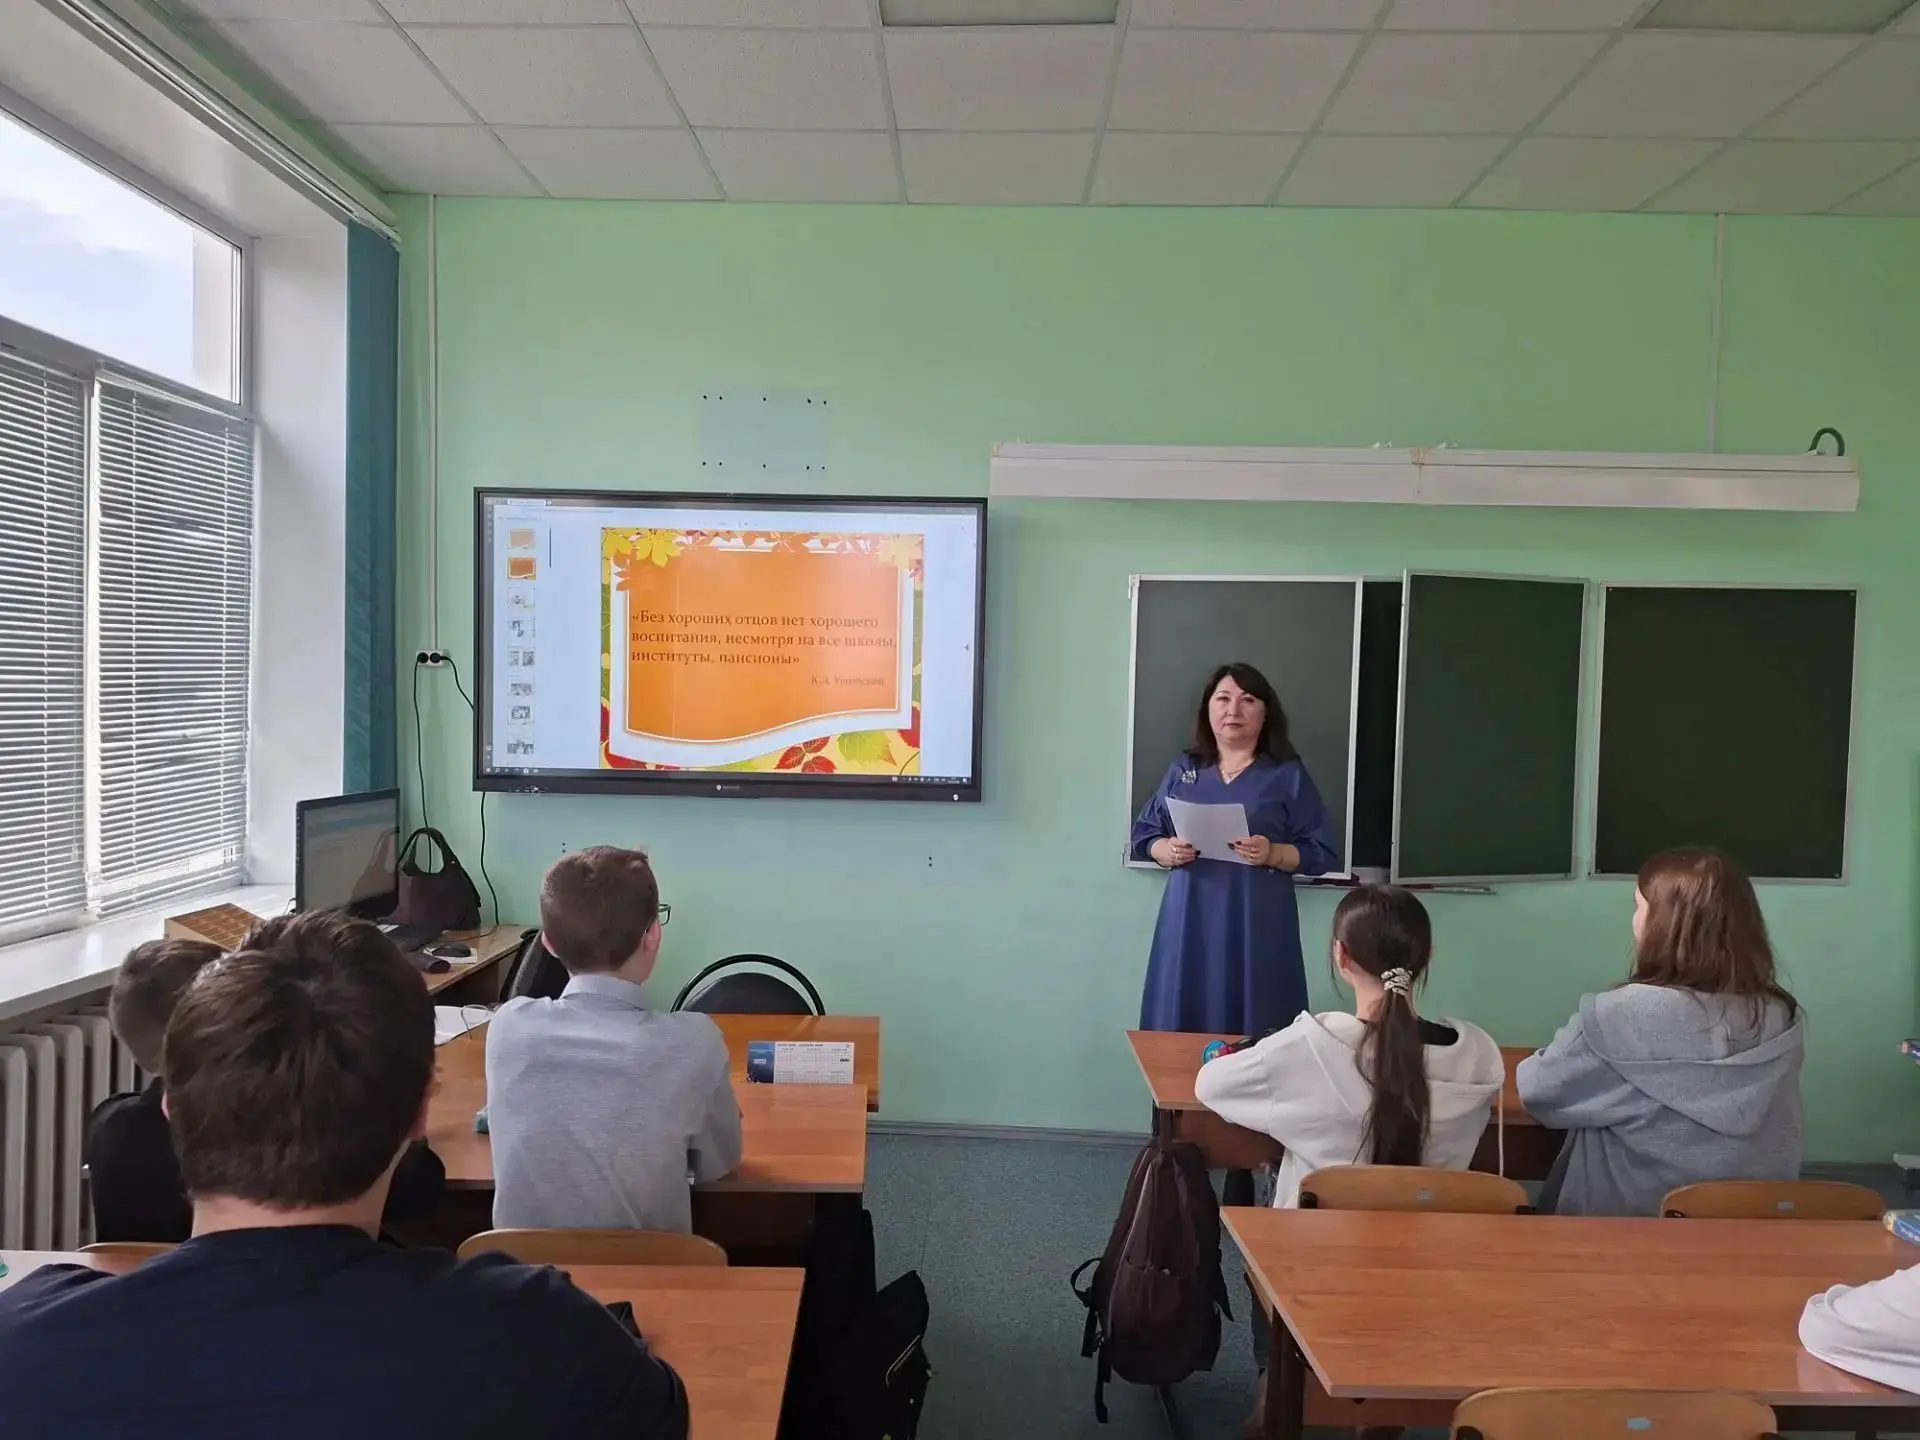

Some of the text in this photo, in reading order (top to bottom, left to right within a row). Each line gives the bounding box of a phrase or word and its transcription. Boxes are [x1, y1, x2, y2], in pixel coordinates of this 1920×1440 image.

[631, 609, 879, 630] «Без хороших отцов нет хорошего
[631, 631, 721, 645] воспитания,
[725, 635, 794, 649] несмотря
[798, 636, 814, 647] на
[818, 637, 840, 647] все
[719, 654, 801, 665] пансионы»
